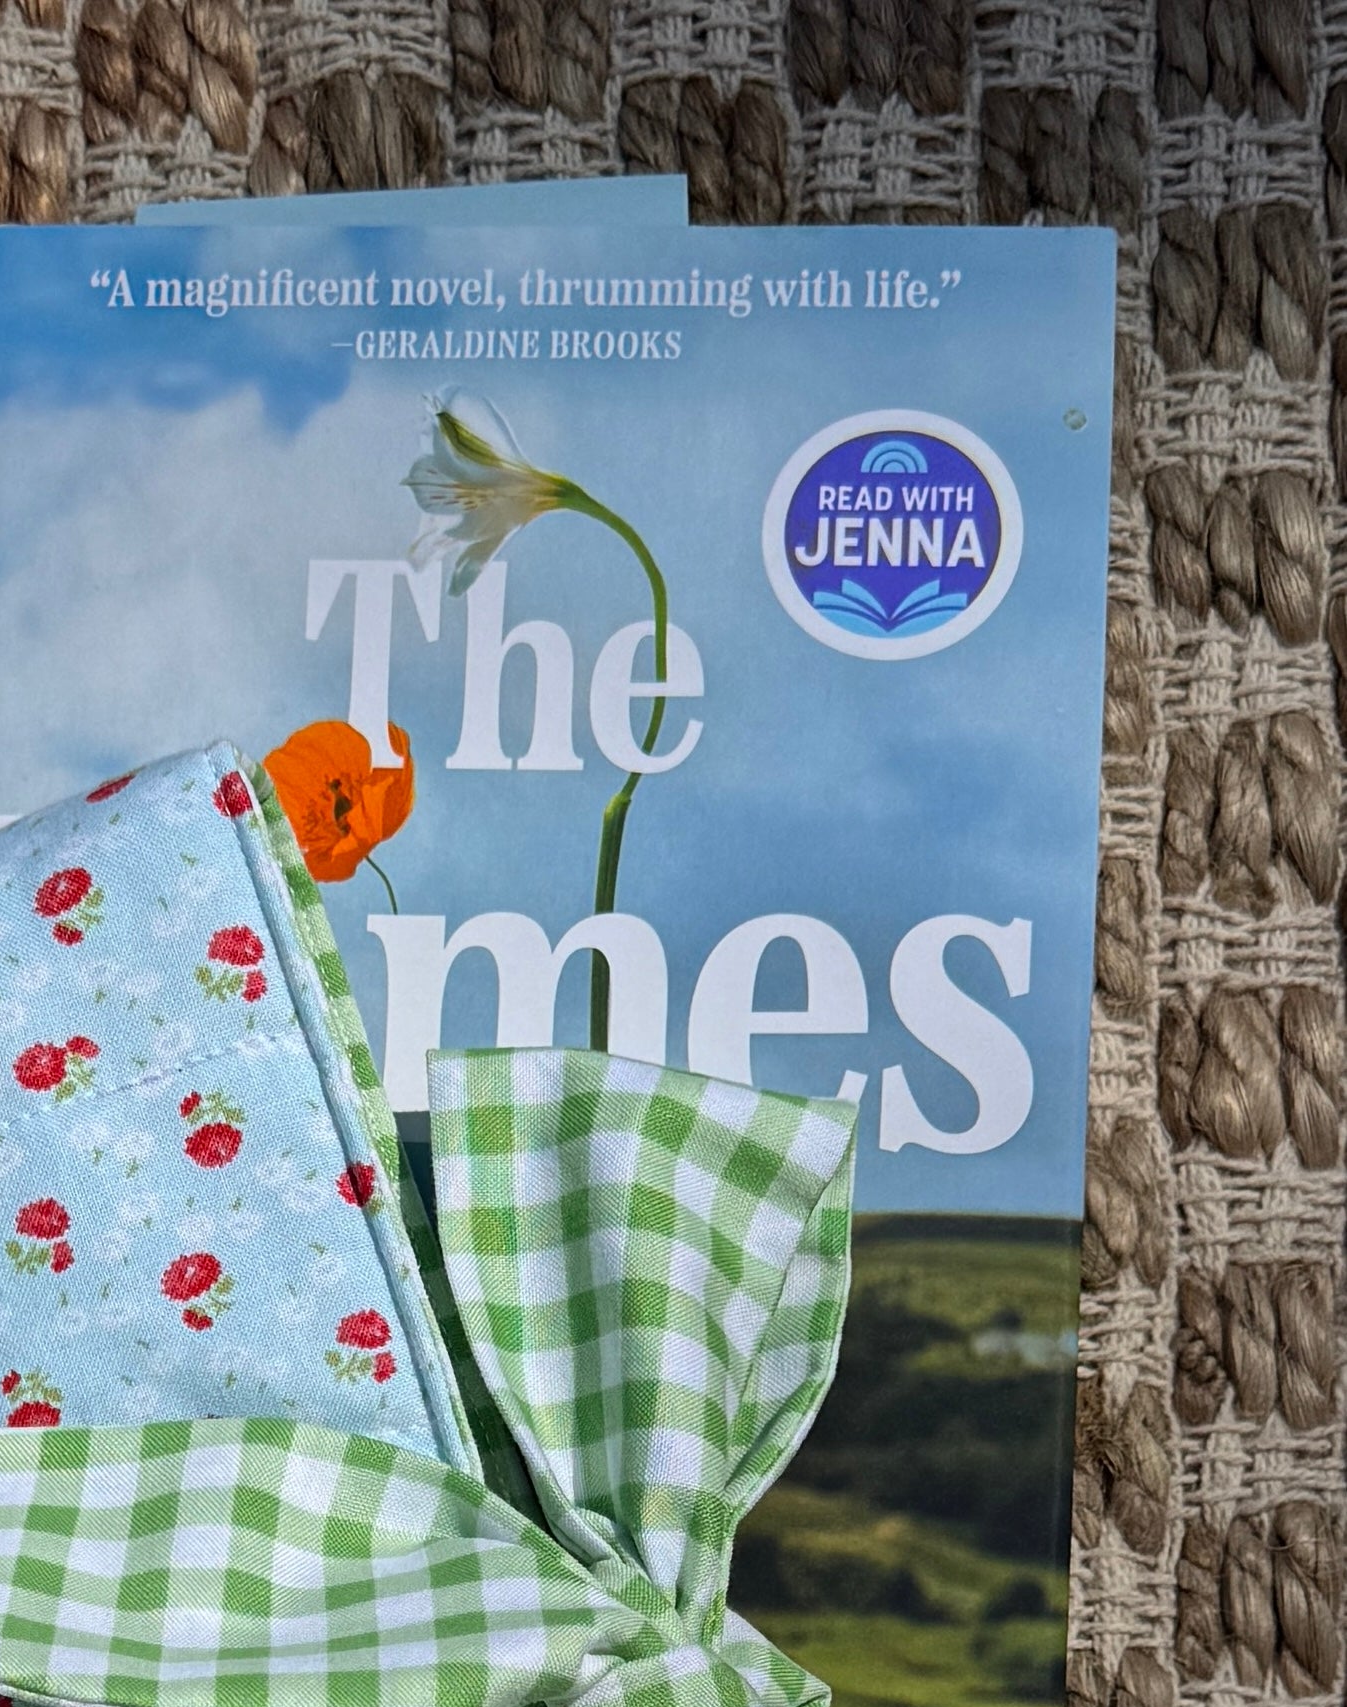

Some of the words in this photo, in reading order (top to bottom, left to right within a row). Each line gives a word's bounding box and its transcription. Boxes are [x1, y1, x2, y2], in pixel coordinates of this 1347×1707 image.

[90, 268, 135, 308] “A
[145, 269, 380, 317] magnificent
[390, 269, 507, 312] novel,
[518, 268, 753, 318] thrumming
[762, 268, 853, 308] with
[863, 269, 963, 309] life.”
[550, 330, 683, 360] BROOKS
[818, 485, 894, 511] READ
[901, 486, 975, 512] WITH
[794, 516, 986, 568] JENNA
[304, 558, 706, 774] The
[366, 911, 1036, 1156] mes
